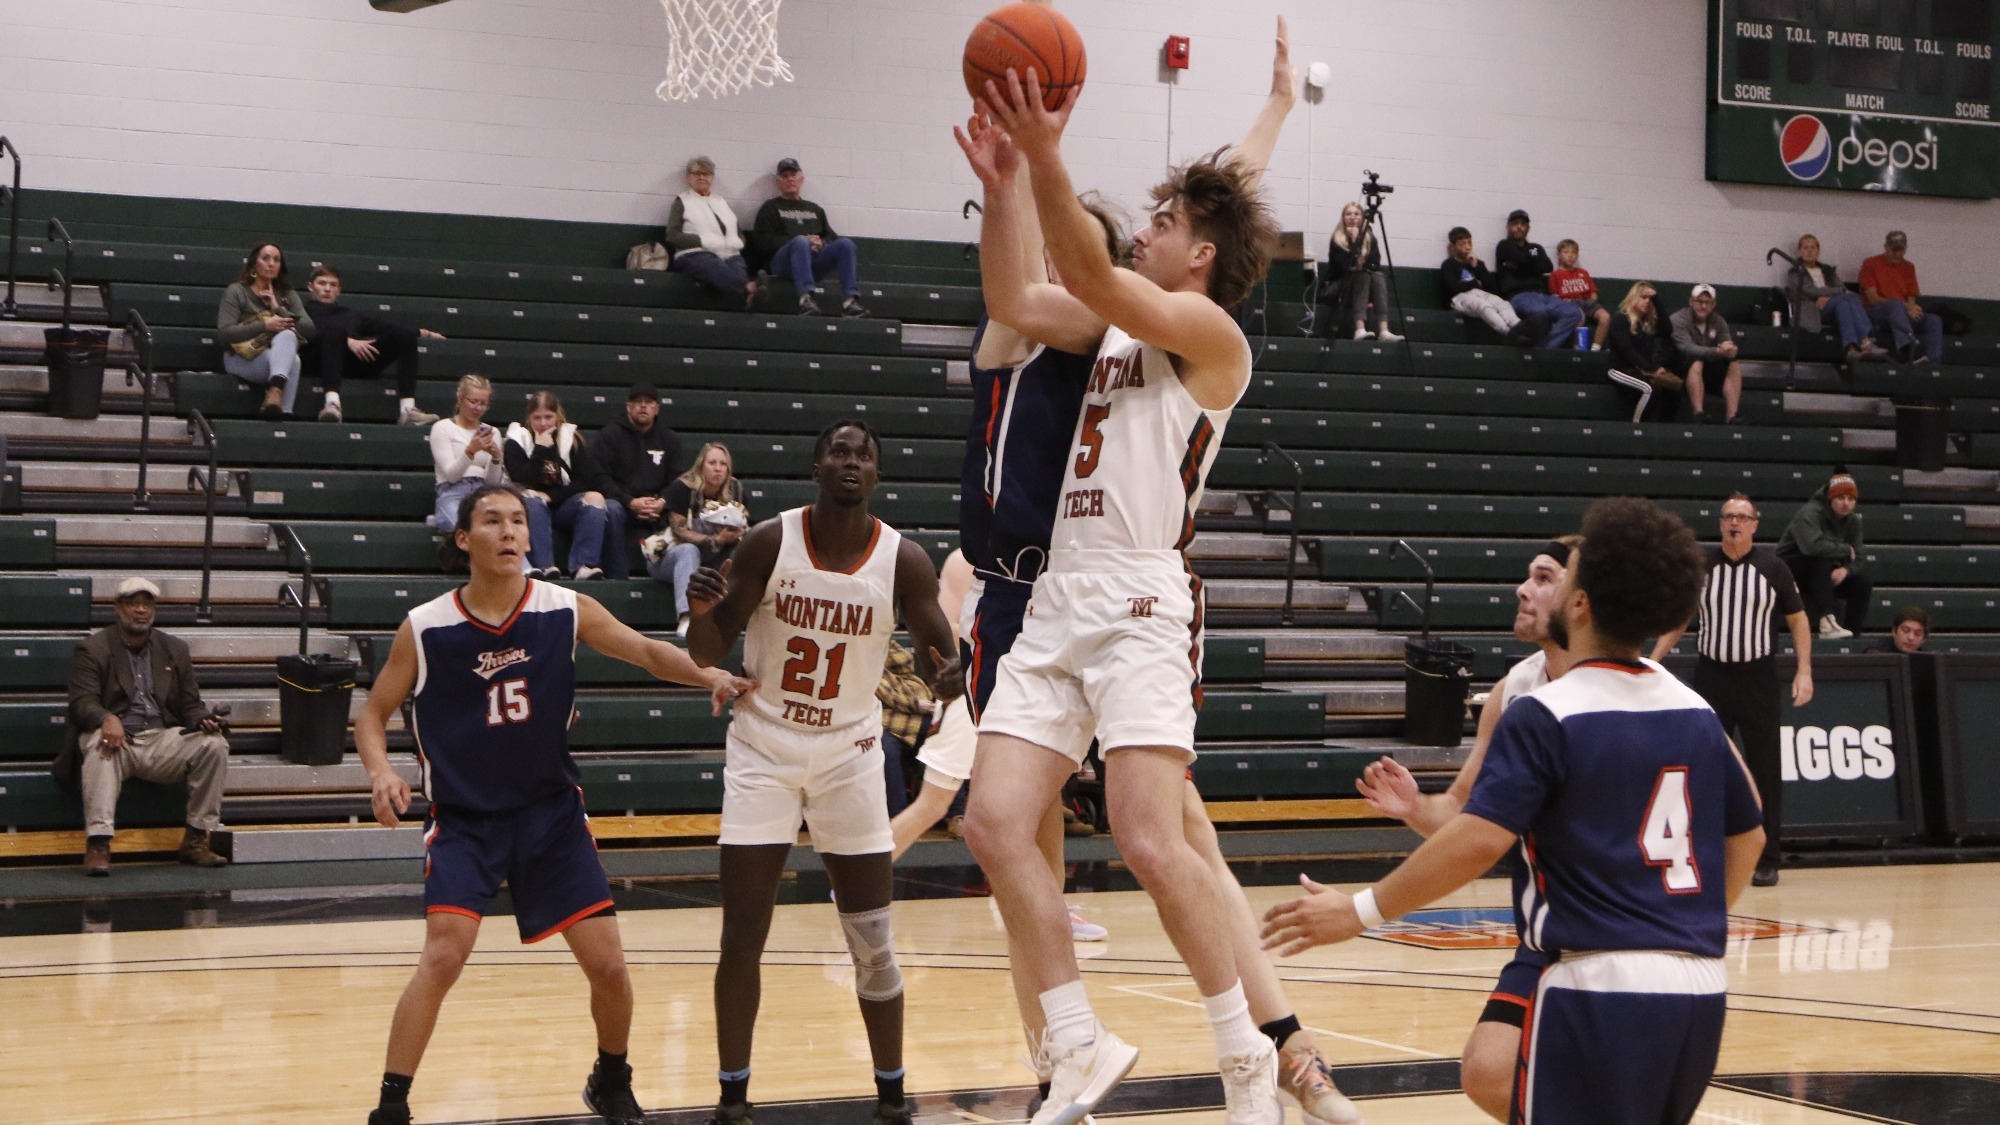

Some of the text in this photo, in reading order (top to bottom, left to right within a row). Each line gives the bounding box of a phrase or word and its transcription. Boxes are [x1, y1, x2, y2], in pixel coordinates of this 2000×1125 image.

[1736, 22, 1773, 39] FOULS
[1786, 27, 1816, 44] T.O.L.
[1827, 31, 1904, 51] PLAYER FOUL
[1915, 39, 1944, 55] T.O.L.
[1956, 43, 1991, 59] FOULS
[1735, 84, 1771, 101] SCORE
[1845, 93, 1884, 110] MATCH
[1955, 102, 1990, 119] SCORE
[1837, 136, 1938, 173] pepsi
[1074, 402, 1111, 479] 5
[1063, 489, 1105, 519] TECH
[775, 591, 873, 636] MONTANA
[781, 635, 847, 701] 21
[486, 677, 531, 726] 15
[781, 699, 833, 727] TECH
[1637, 765, 1702, 894] 4
